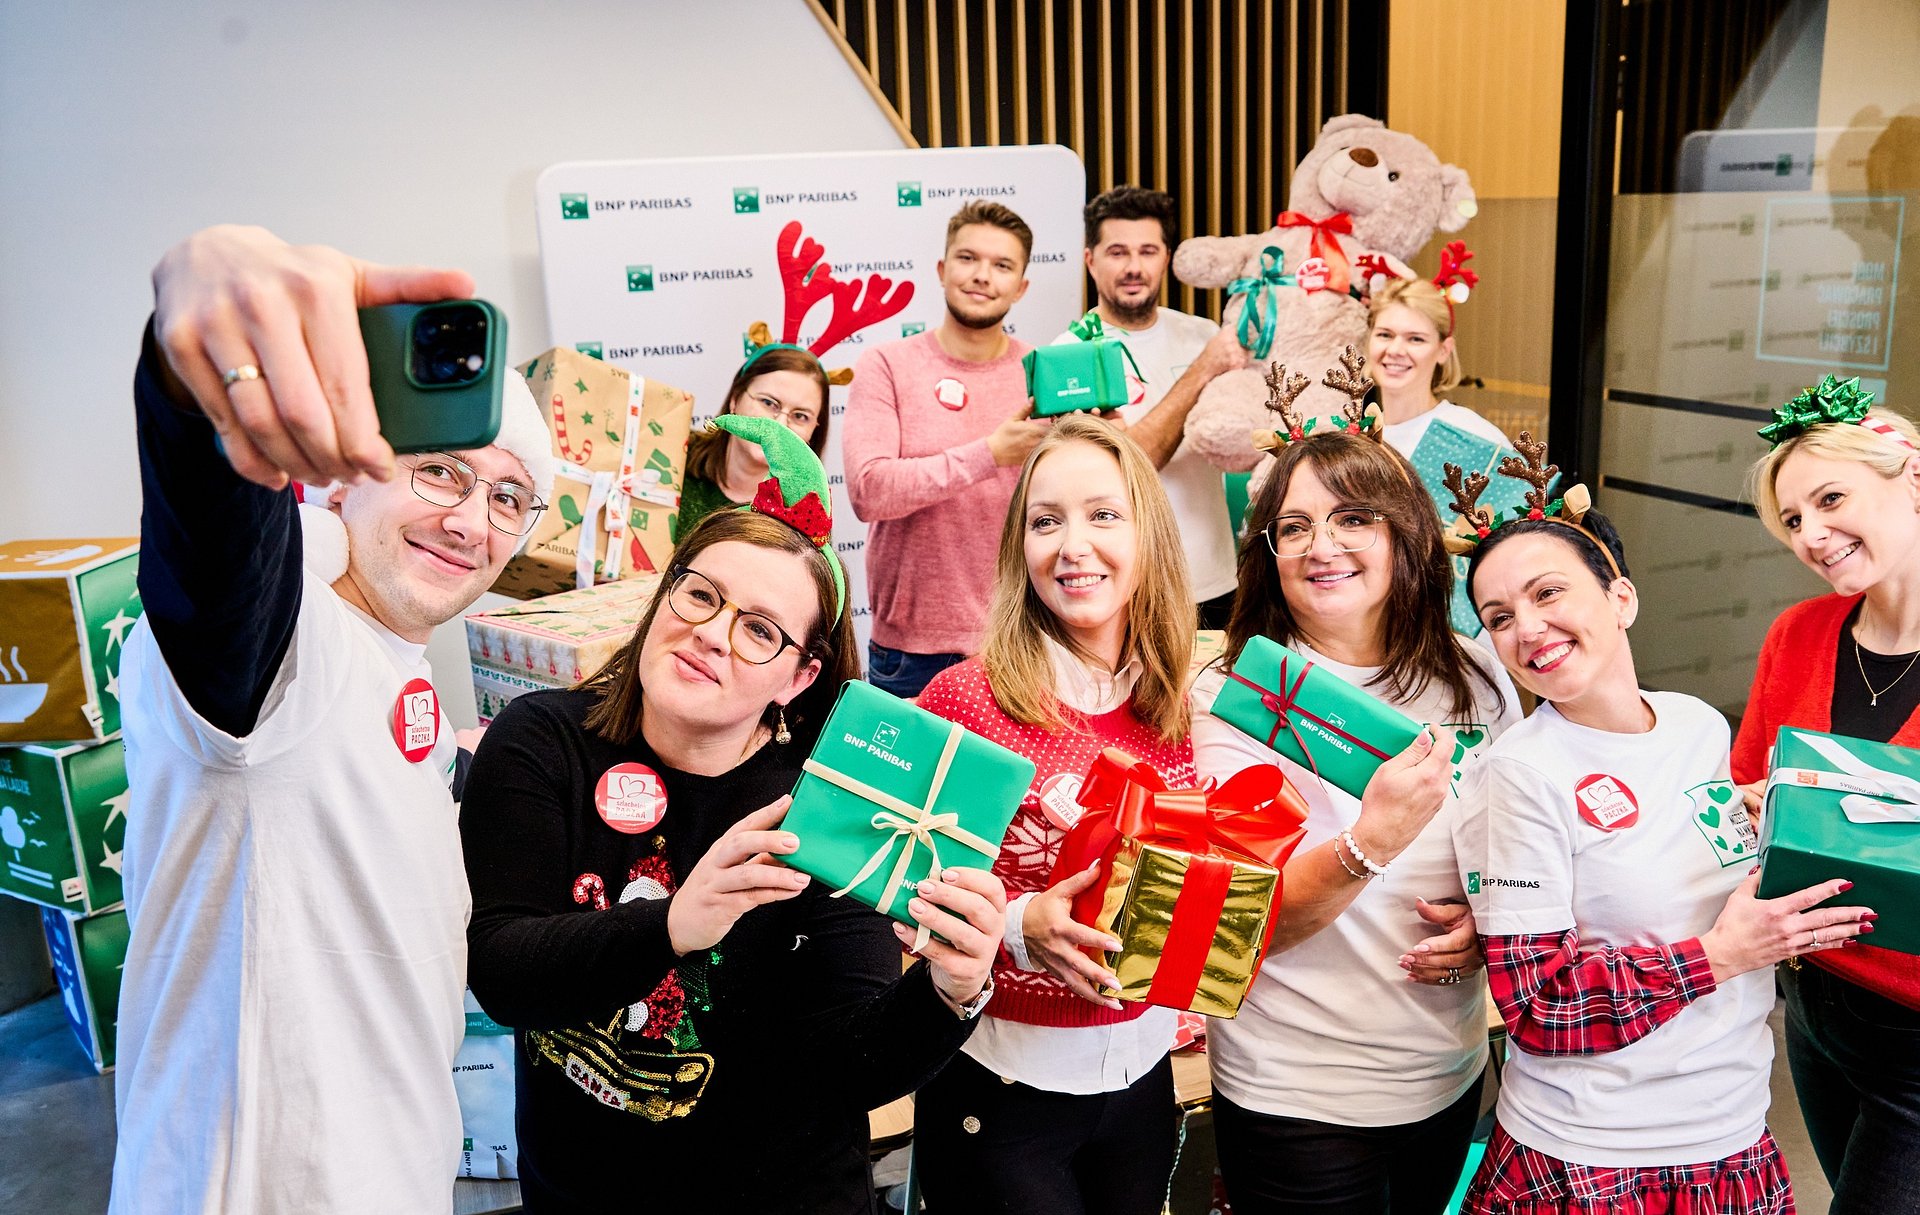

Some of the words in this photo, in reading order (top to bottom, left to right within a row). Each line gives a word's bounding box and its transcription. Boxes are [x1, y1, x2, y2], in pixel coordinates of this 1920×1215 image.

[765, 194, 794, 204] BNP
[799, 191, 858, 203] PARIBAS
[928, 188, 955, 198] BNP
[960, 185, 1016, 197] PARIBAS
[595, 200, 625, 211] BNP
[630, 197, 692, 210] PARIBAS
[833, 263, 852, 273] NP
[856, 260, 914, 272] PARIBAS
[659, 272, 689, 282] BNP
[693, 267, 753, 280] PARIBAS
[609, 347, 638, 358] BNP
[643, 343, 703, 356] PARIBAS
[838, 541, 864, 551] BNP
[1300, 719, 1319, 731] BNP
[1318, 730, 1353, 754] PARIBAS
[844, 733, 867, 748] BNP
[867, 744, 912, 771] PARIBAS
[1604, 805, 1629, 820] PACZKA
[902, 879, 918, 891] NP
[1497, 879, 1540, 888] PARIBAS
[462, 1063, 494, 1071] PARIBAS
[570, 1063, 622, 1107] SANTA
